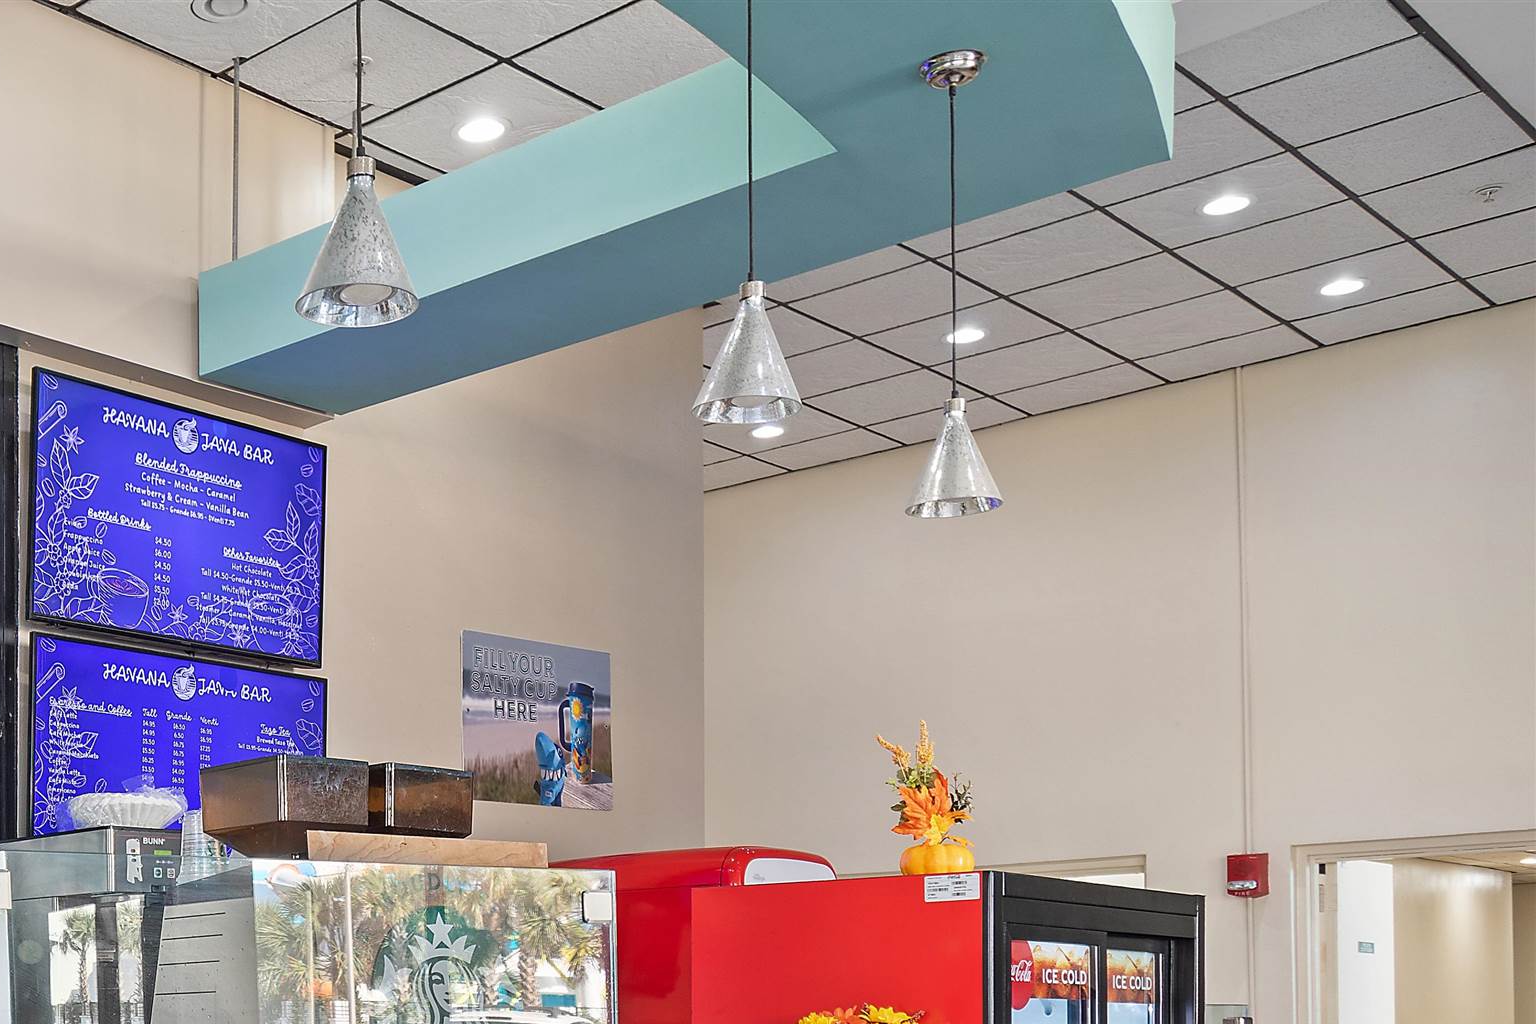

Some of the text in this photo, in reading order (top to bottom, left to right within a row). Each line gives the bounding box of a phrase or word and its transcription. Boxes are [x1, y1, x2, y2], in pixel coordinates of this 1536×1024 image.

[102, 406, 275, 466] HAVANA JAVA BAR
[134, 452, 243, 490] Blended Frappuccino
[141, 472, 236, 502] Coffee Mocha Caramel
[124, 482, 250, 519] Strawberry & Cream Vanilla Bean
[140, 499, 151, 507] Tall
[169, 505, 190, 517] Grande
[87, 508, 152, 531] Bottled Drinks
[64, 529, 104, 545] Frappuccino
[88, 560, 106, 570] Juice
[201, 568, 212, 577] Tall
[231, 563, 273, 578] Hot Chocolate
[201, 592, 212, 600] Tall
[221, 584, 239, 594] White
[252, 590, 281, 603] Chocolate
[473, 646, 556, 678] FILL YOUR
[102, 663, 171, 689] HAVANA
[240, 683, 273, 703] BAR
[471, 671, 558, 702] SALTY CUP
[87, 701, 107, 712] and
[107, 704, 133, 717] Coffee
[142, 708, 158, 718] Tall
[165, 710, 193, 721] Grande
[199, 716, 220, 726] Venti
[493, 698, 539, 723] HERE
[142, 837, 165, 846] BUNN
[1042, 968, 1088, 985] ICE COLD
[1112, 974, 1153, 991] ICE COLD
